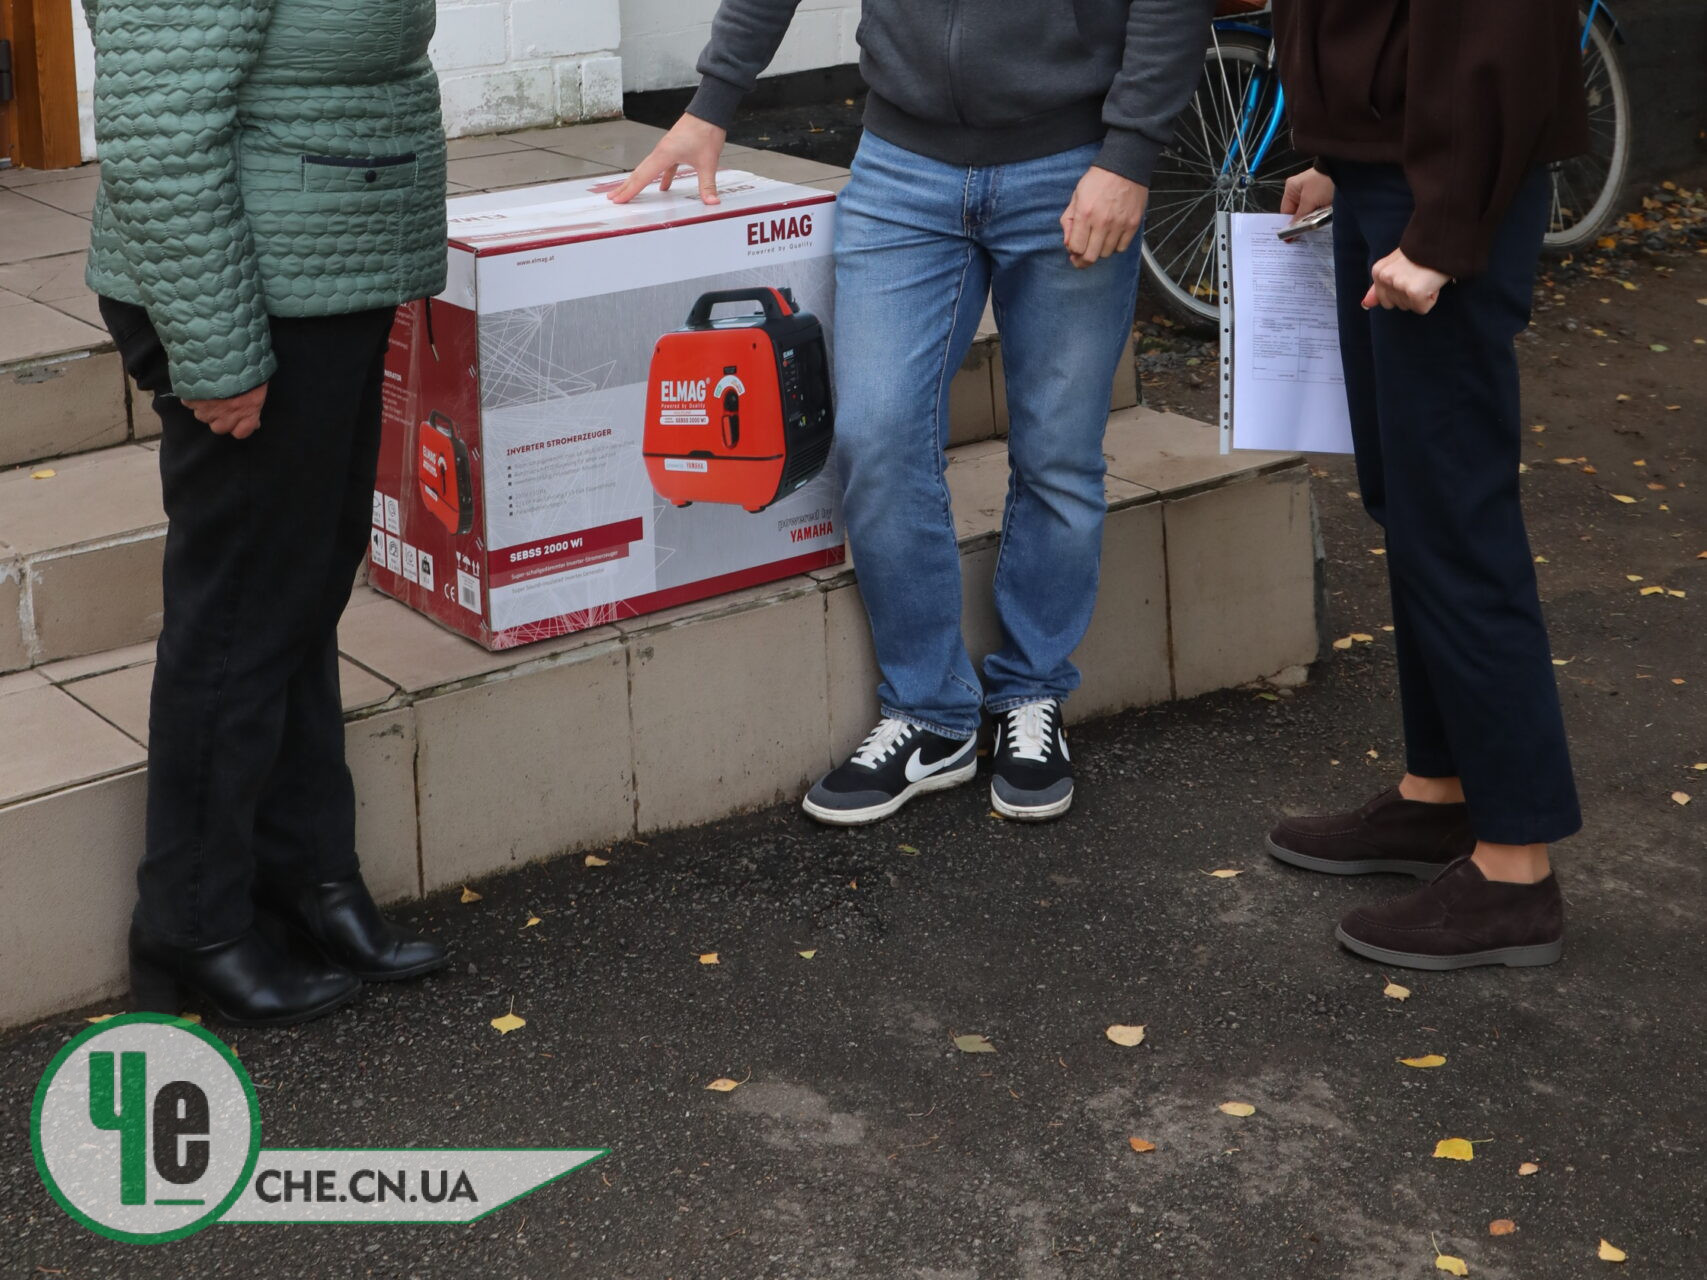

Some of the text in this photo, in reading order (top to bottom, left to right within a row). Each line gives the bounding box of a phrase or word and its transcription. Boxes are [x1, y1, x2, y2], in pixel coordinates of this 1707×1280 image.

[747, 214, 812, 246] ELMAG
[747, 240, 814, 256] Powered by Quality
[516, 255, 555, 266] www.elmag.at
[661, 379, 706, 402] ELMAG
[506, 441, 545, 456] INVERTER
[546, 429, 612, 448] STROMERZEUGER
[790, 521, 833, 543] YAMAHA
[510, 537, 583, 563] SEBSS 2000 Wi
